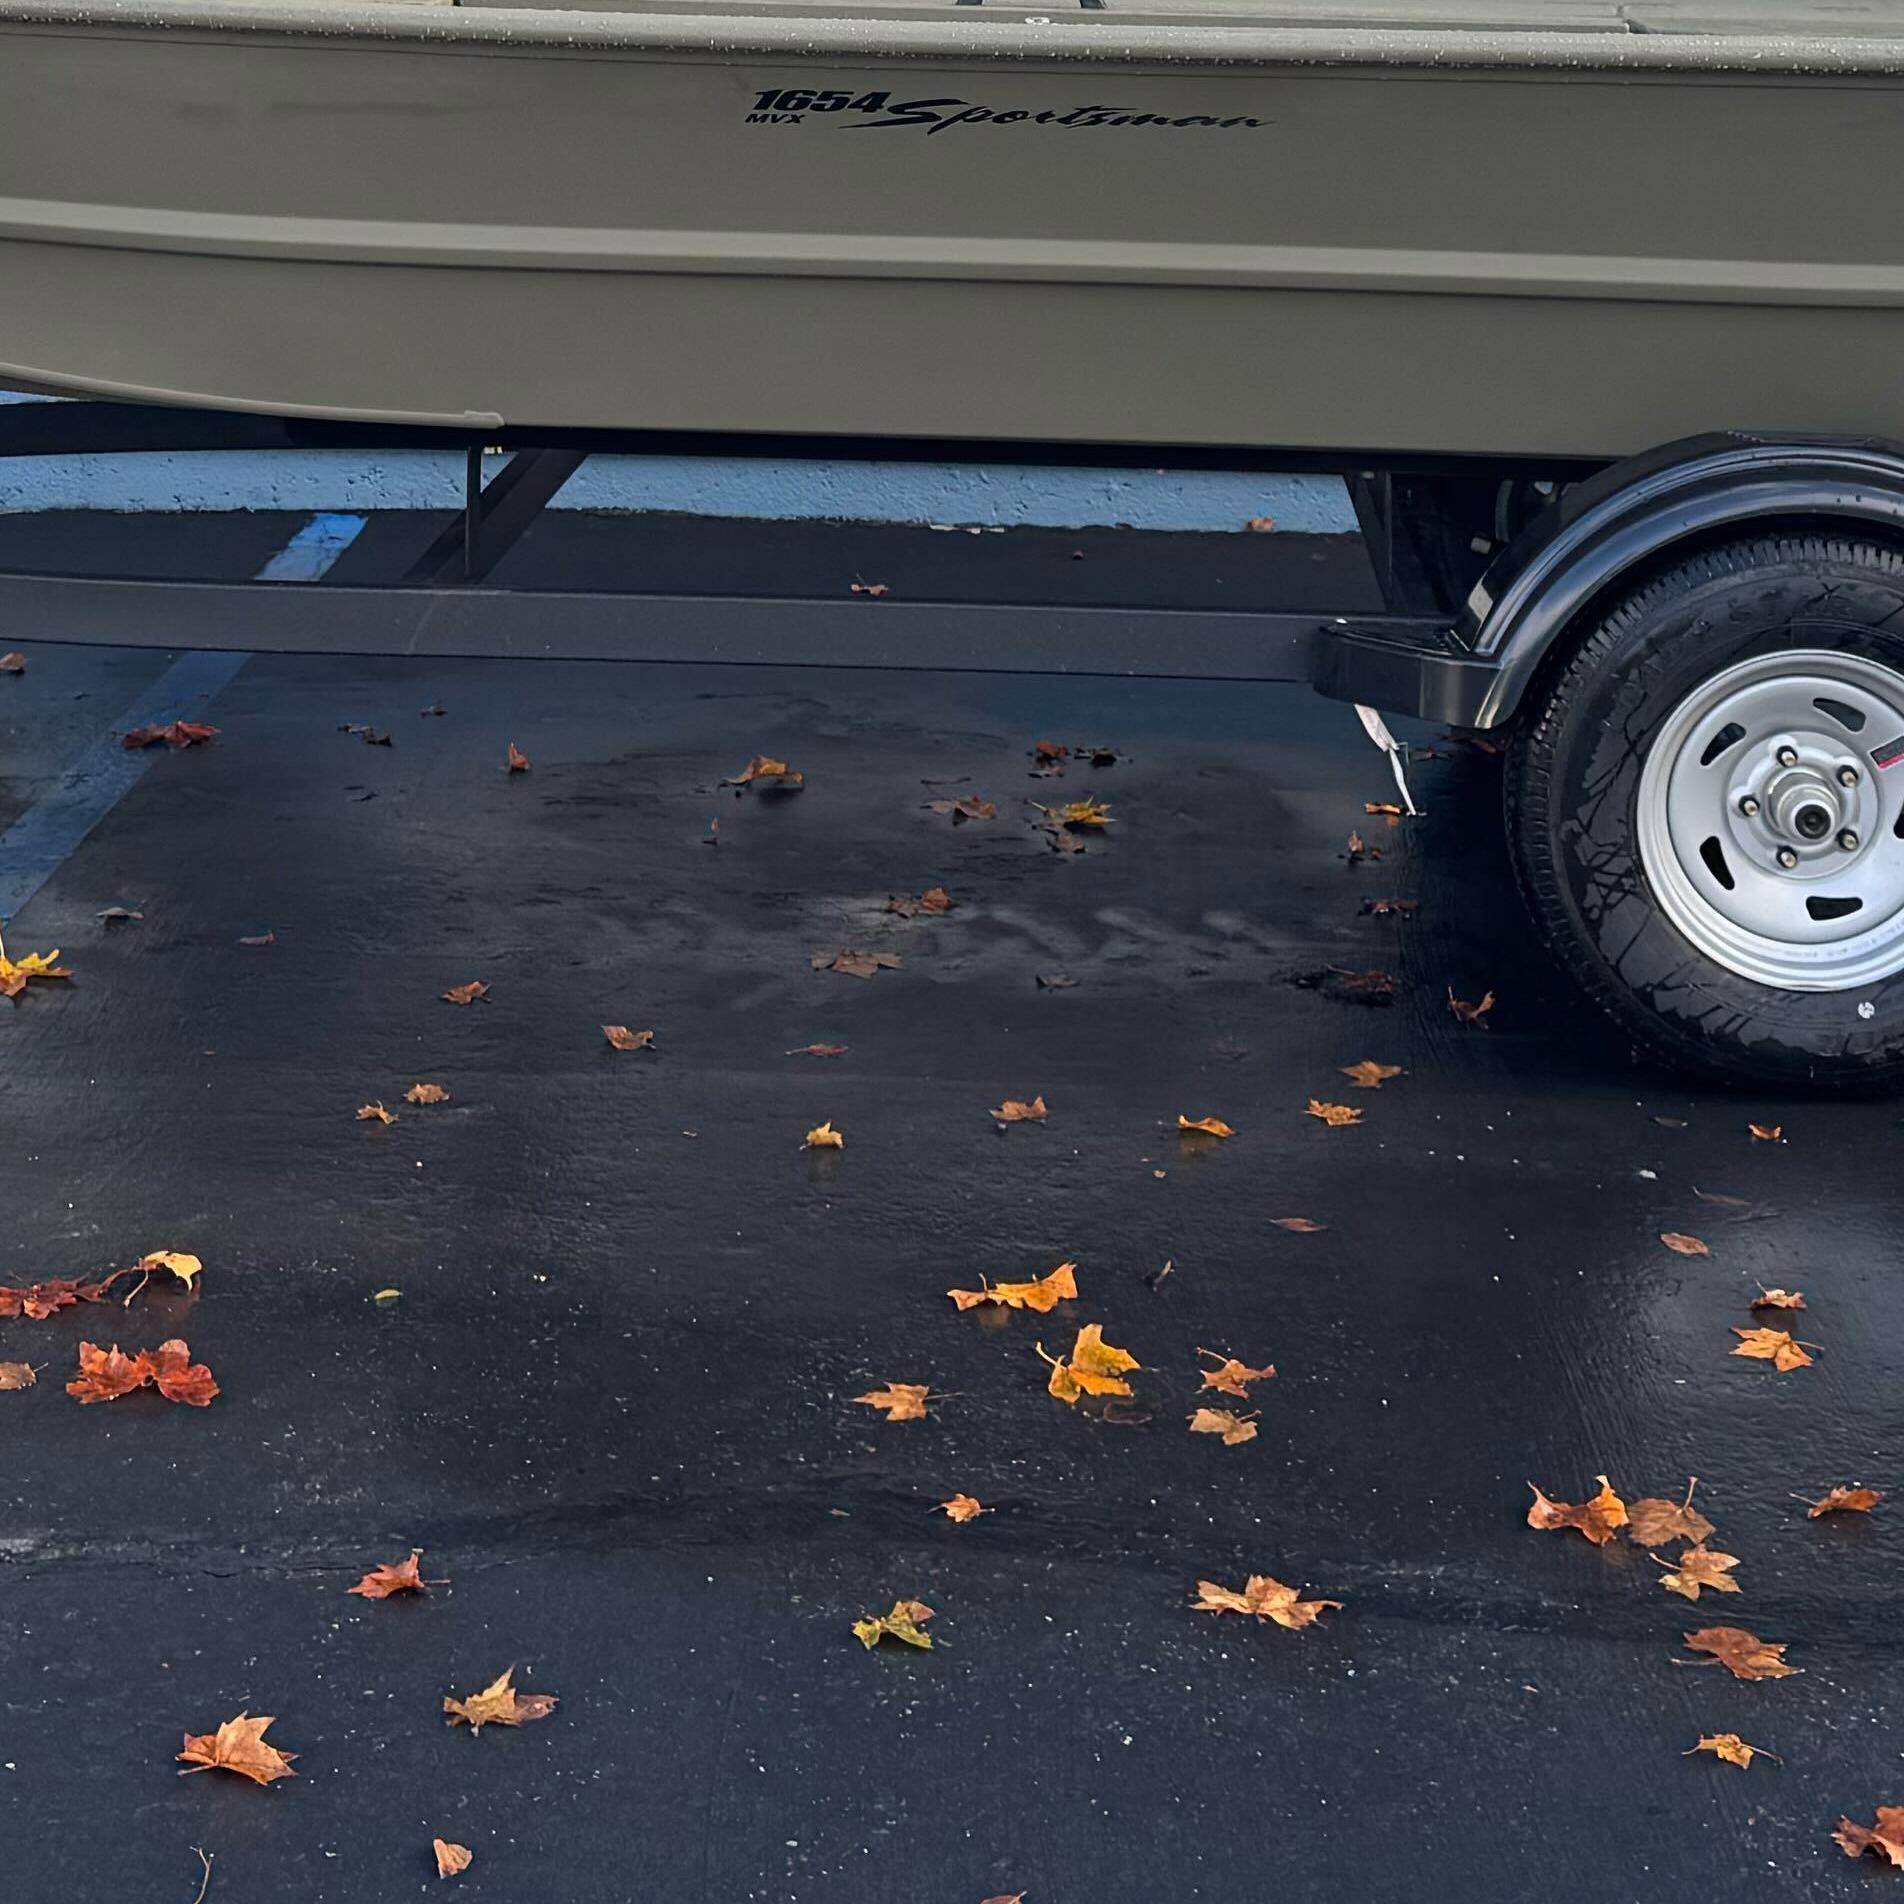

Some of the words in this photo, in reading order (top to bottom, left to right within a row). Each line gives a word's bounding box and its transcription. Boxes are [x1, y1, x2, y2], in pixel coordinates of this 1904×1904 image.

[744, 113, 806, 124] MVX
[752, 88, 892, 113] 1654
[839, 98, 1276, 136] Sportsman
